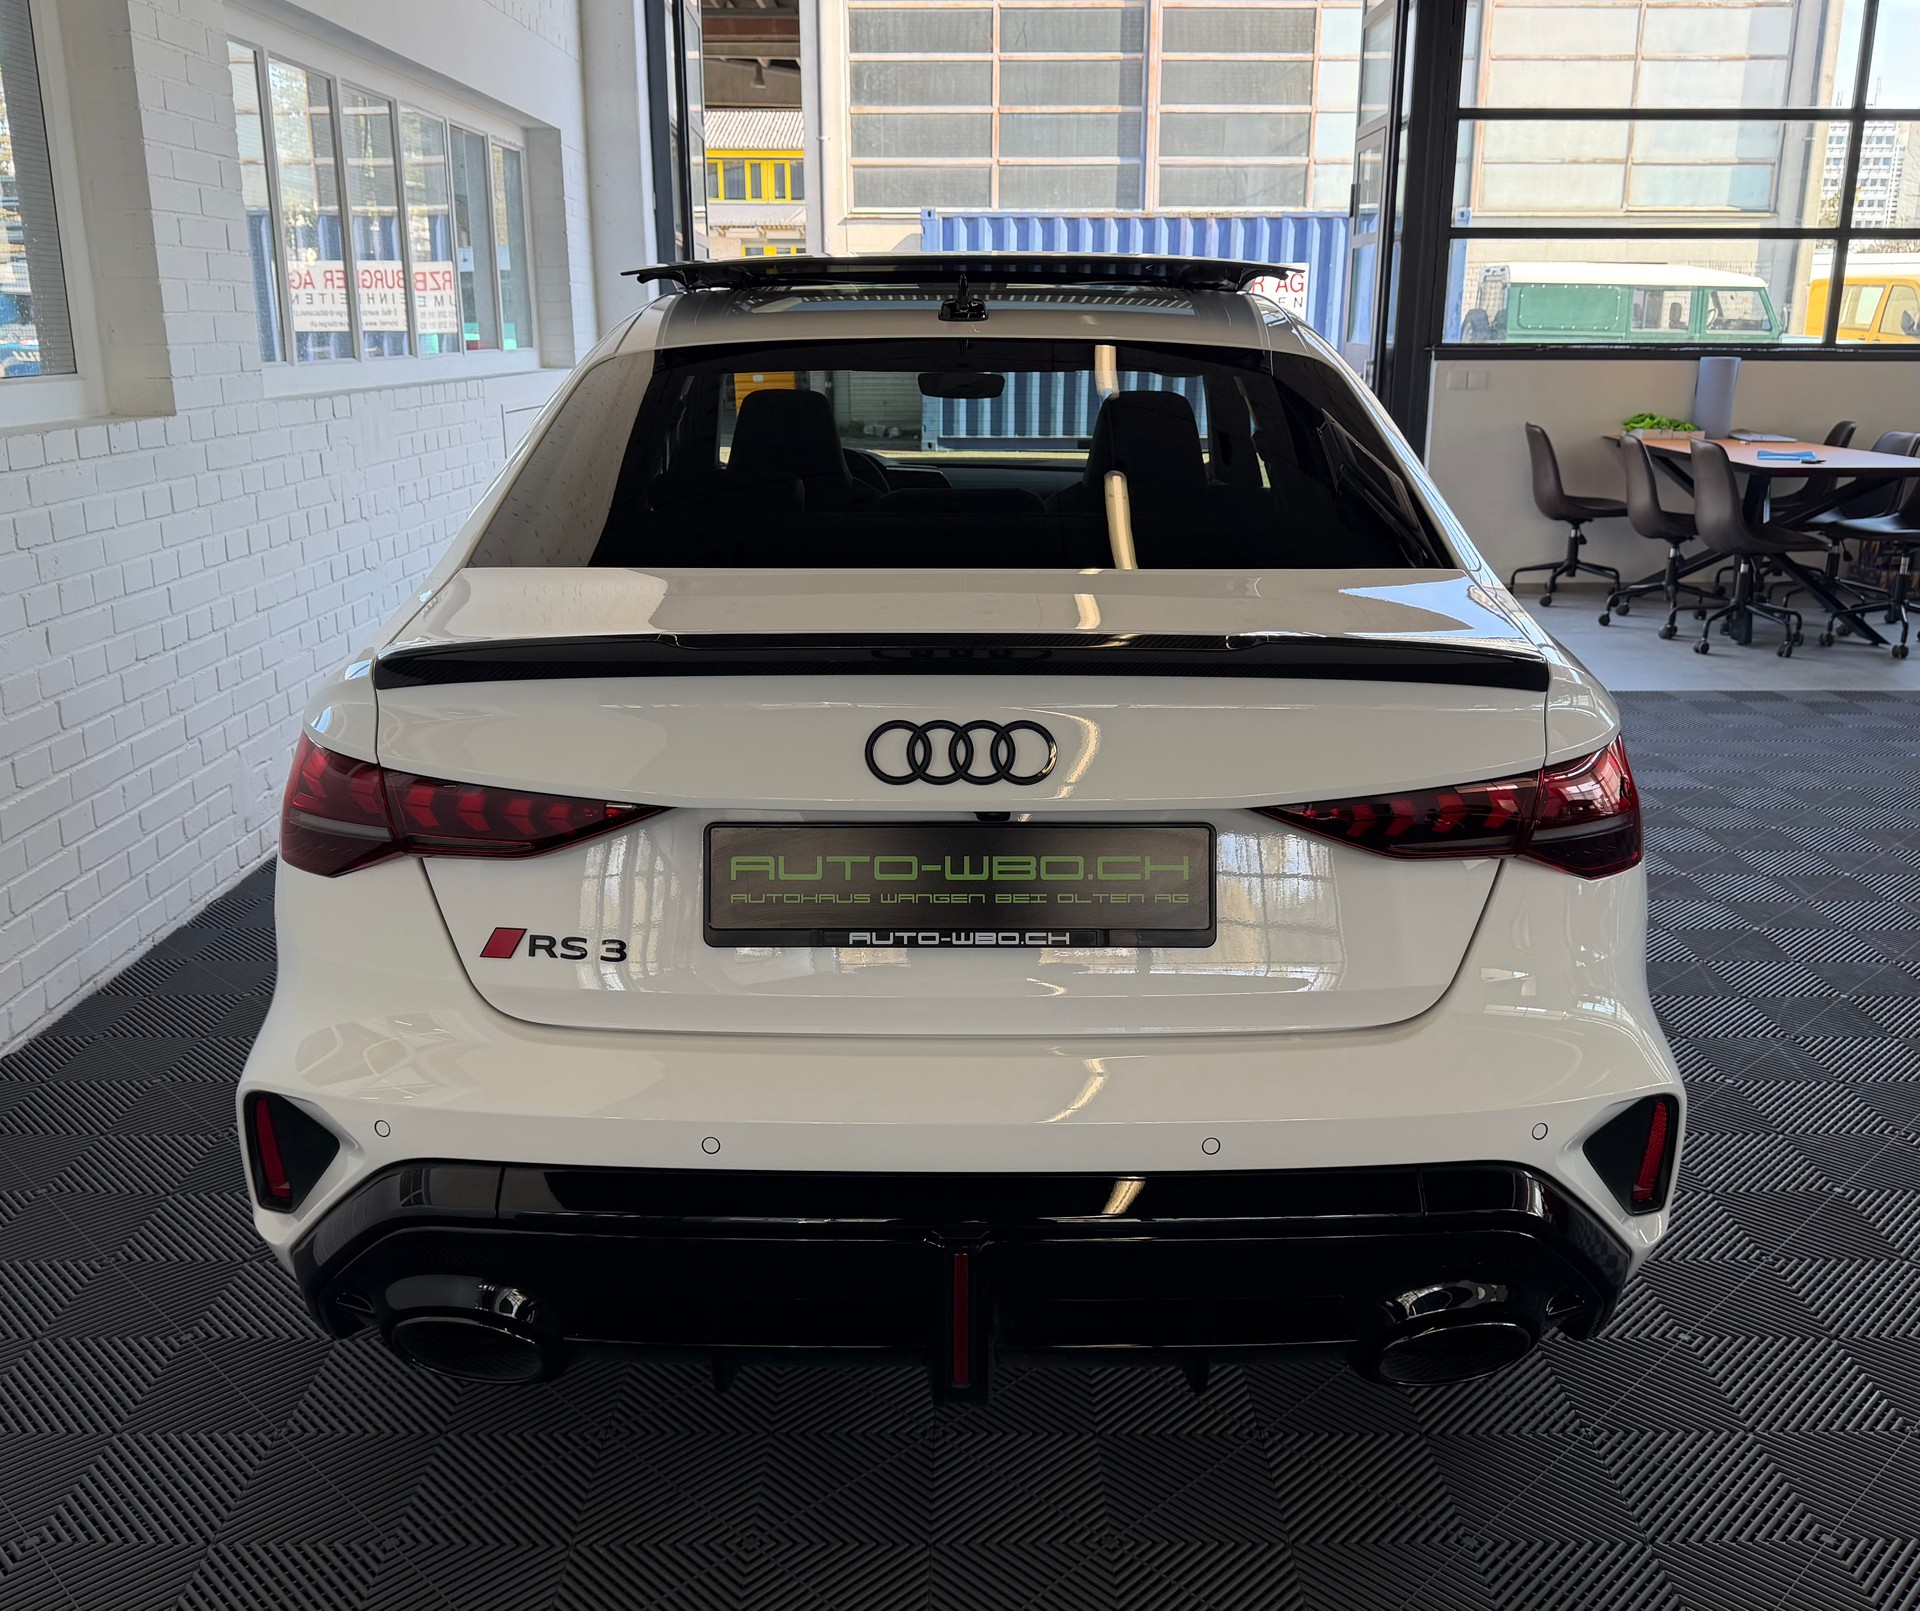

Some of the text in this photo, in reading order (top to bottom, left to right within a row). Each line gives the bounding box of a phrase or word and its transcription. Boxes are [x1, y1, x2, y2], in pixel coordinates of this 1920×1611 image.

[1275, 272, 1304, 293] AG
[730, 855, 1190, 881] AUTO-WBO.CH
[730, 893, 1190, 904] AUTOHAUS WANGEN BEI OLTEN AG
[528, 934, 627, 962] RS 3
[848, 931, 1071, 945] AUTO-WBO.CH
